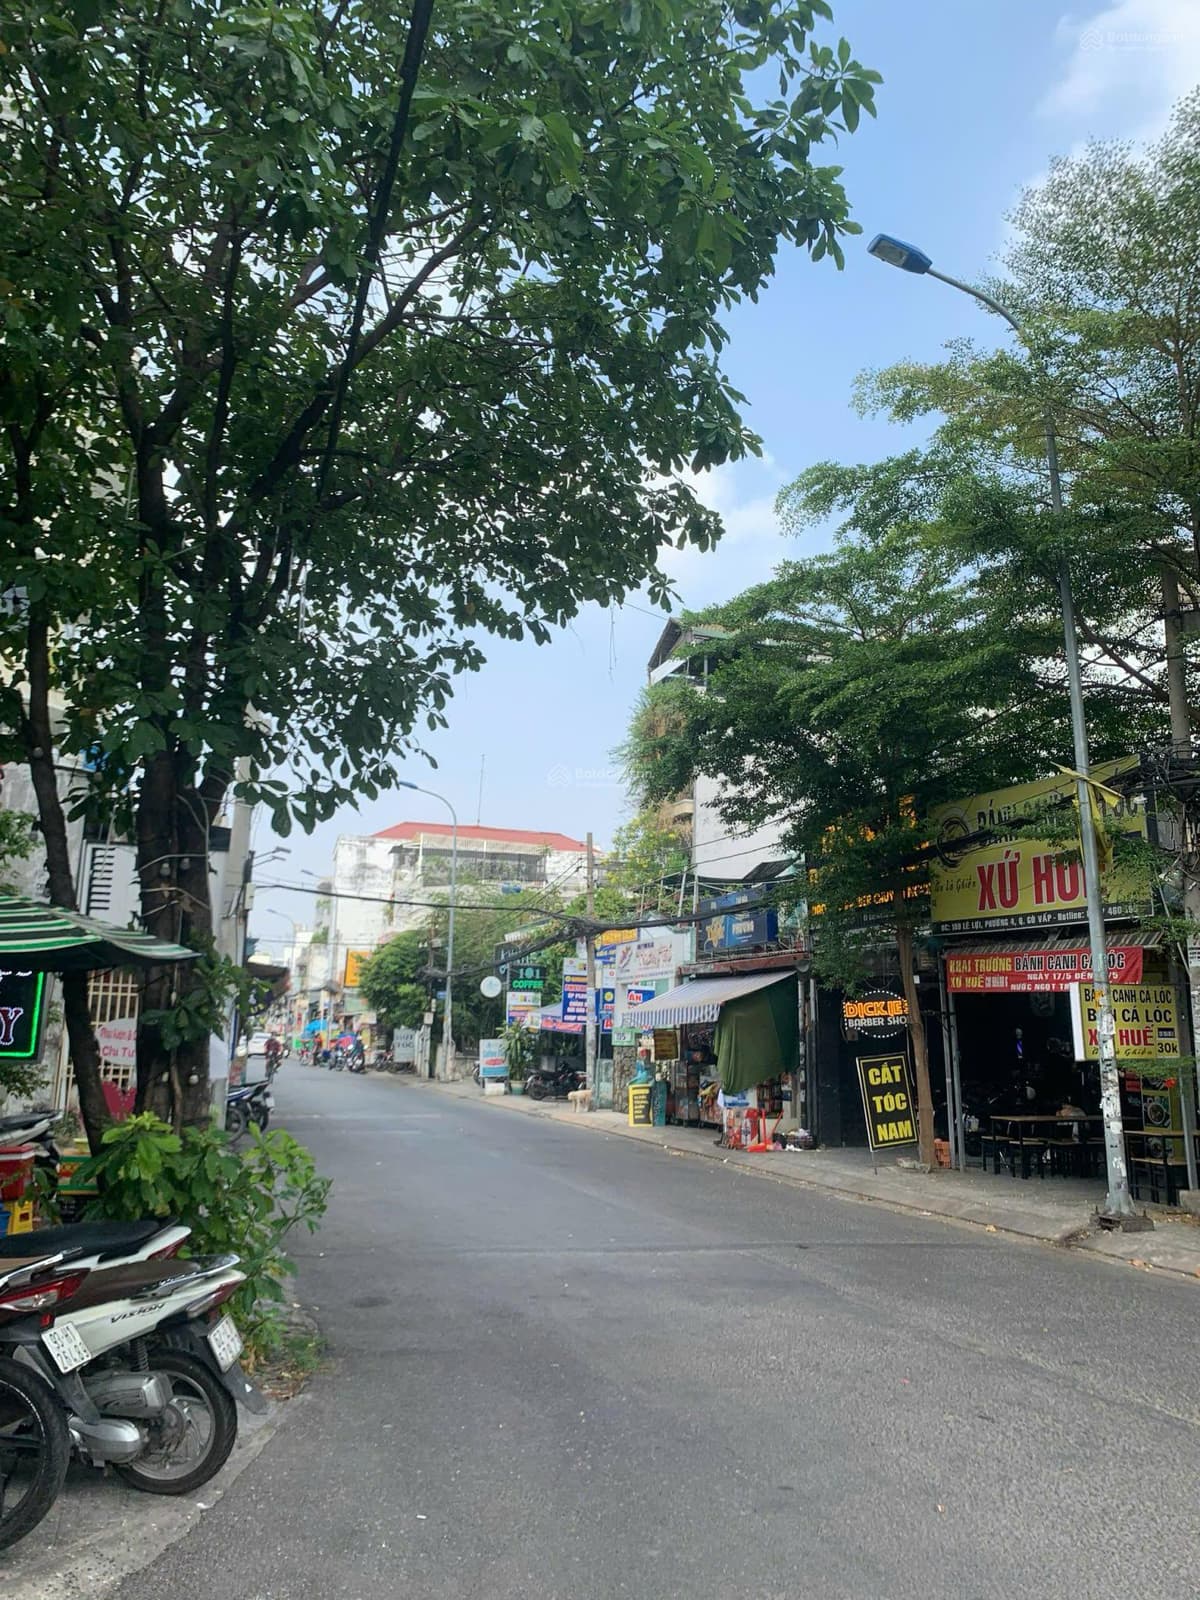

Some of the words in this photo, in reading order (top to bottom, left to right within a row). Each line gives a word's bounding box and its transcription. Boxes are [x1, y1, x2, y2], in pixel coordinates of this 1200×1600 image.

[976, 849, 1021, 911] XỨ
[1032, 852, 1088, 905] HU
[1015, 953, 1044, 972] BÁNH
[1047, 953, 1077, 971] CANH
[512, 980, 544, 989] COFFEE
[1053, 972, 1072, 981] 17/5
[1112, 989, 1137, 1003] CANH
[1155, 987, 1172, 1004] LÓC
[848, 1017, 885, 1028] BARBER
[887, 1016, 907, 1025] SHO
[1122, 1006, 1140, 1022] CÁ
[1145, 1006, 1172, 1023] LÓC
[1119, 1024, 1155, 1046] HUẾ
[1157, 1042, 1178, 1054] 30k
[872, 1091, 908, 1114] TÓC
[876, 1119, 913, 1142] NAM
